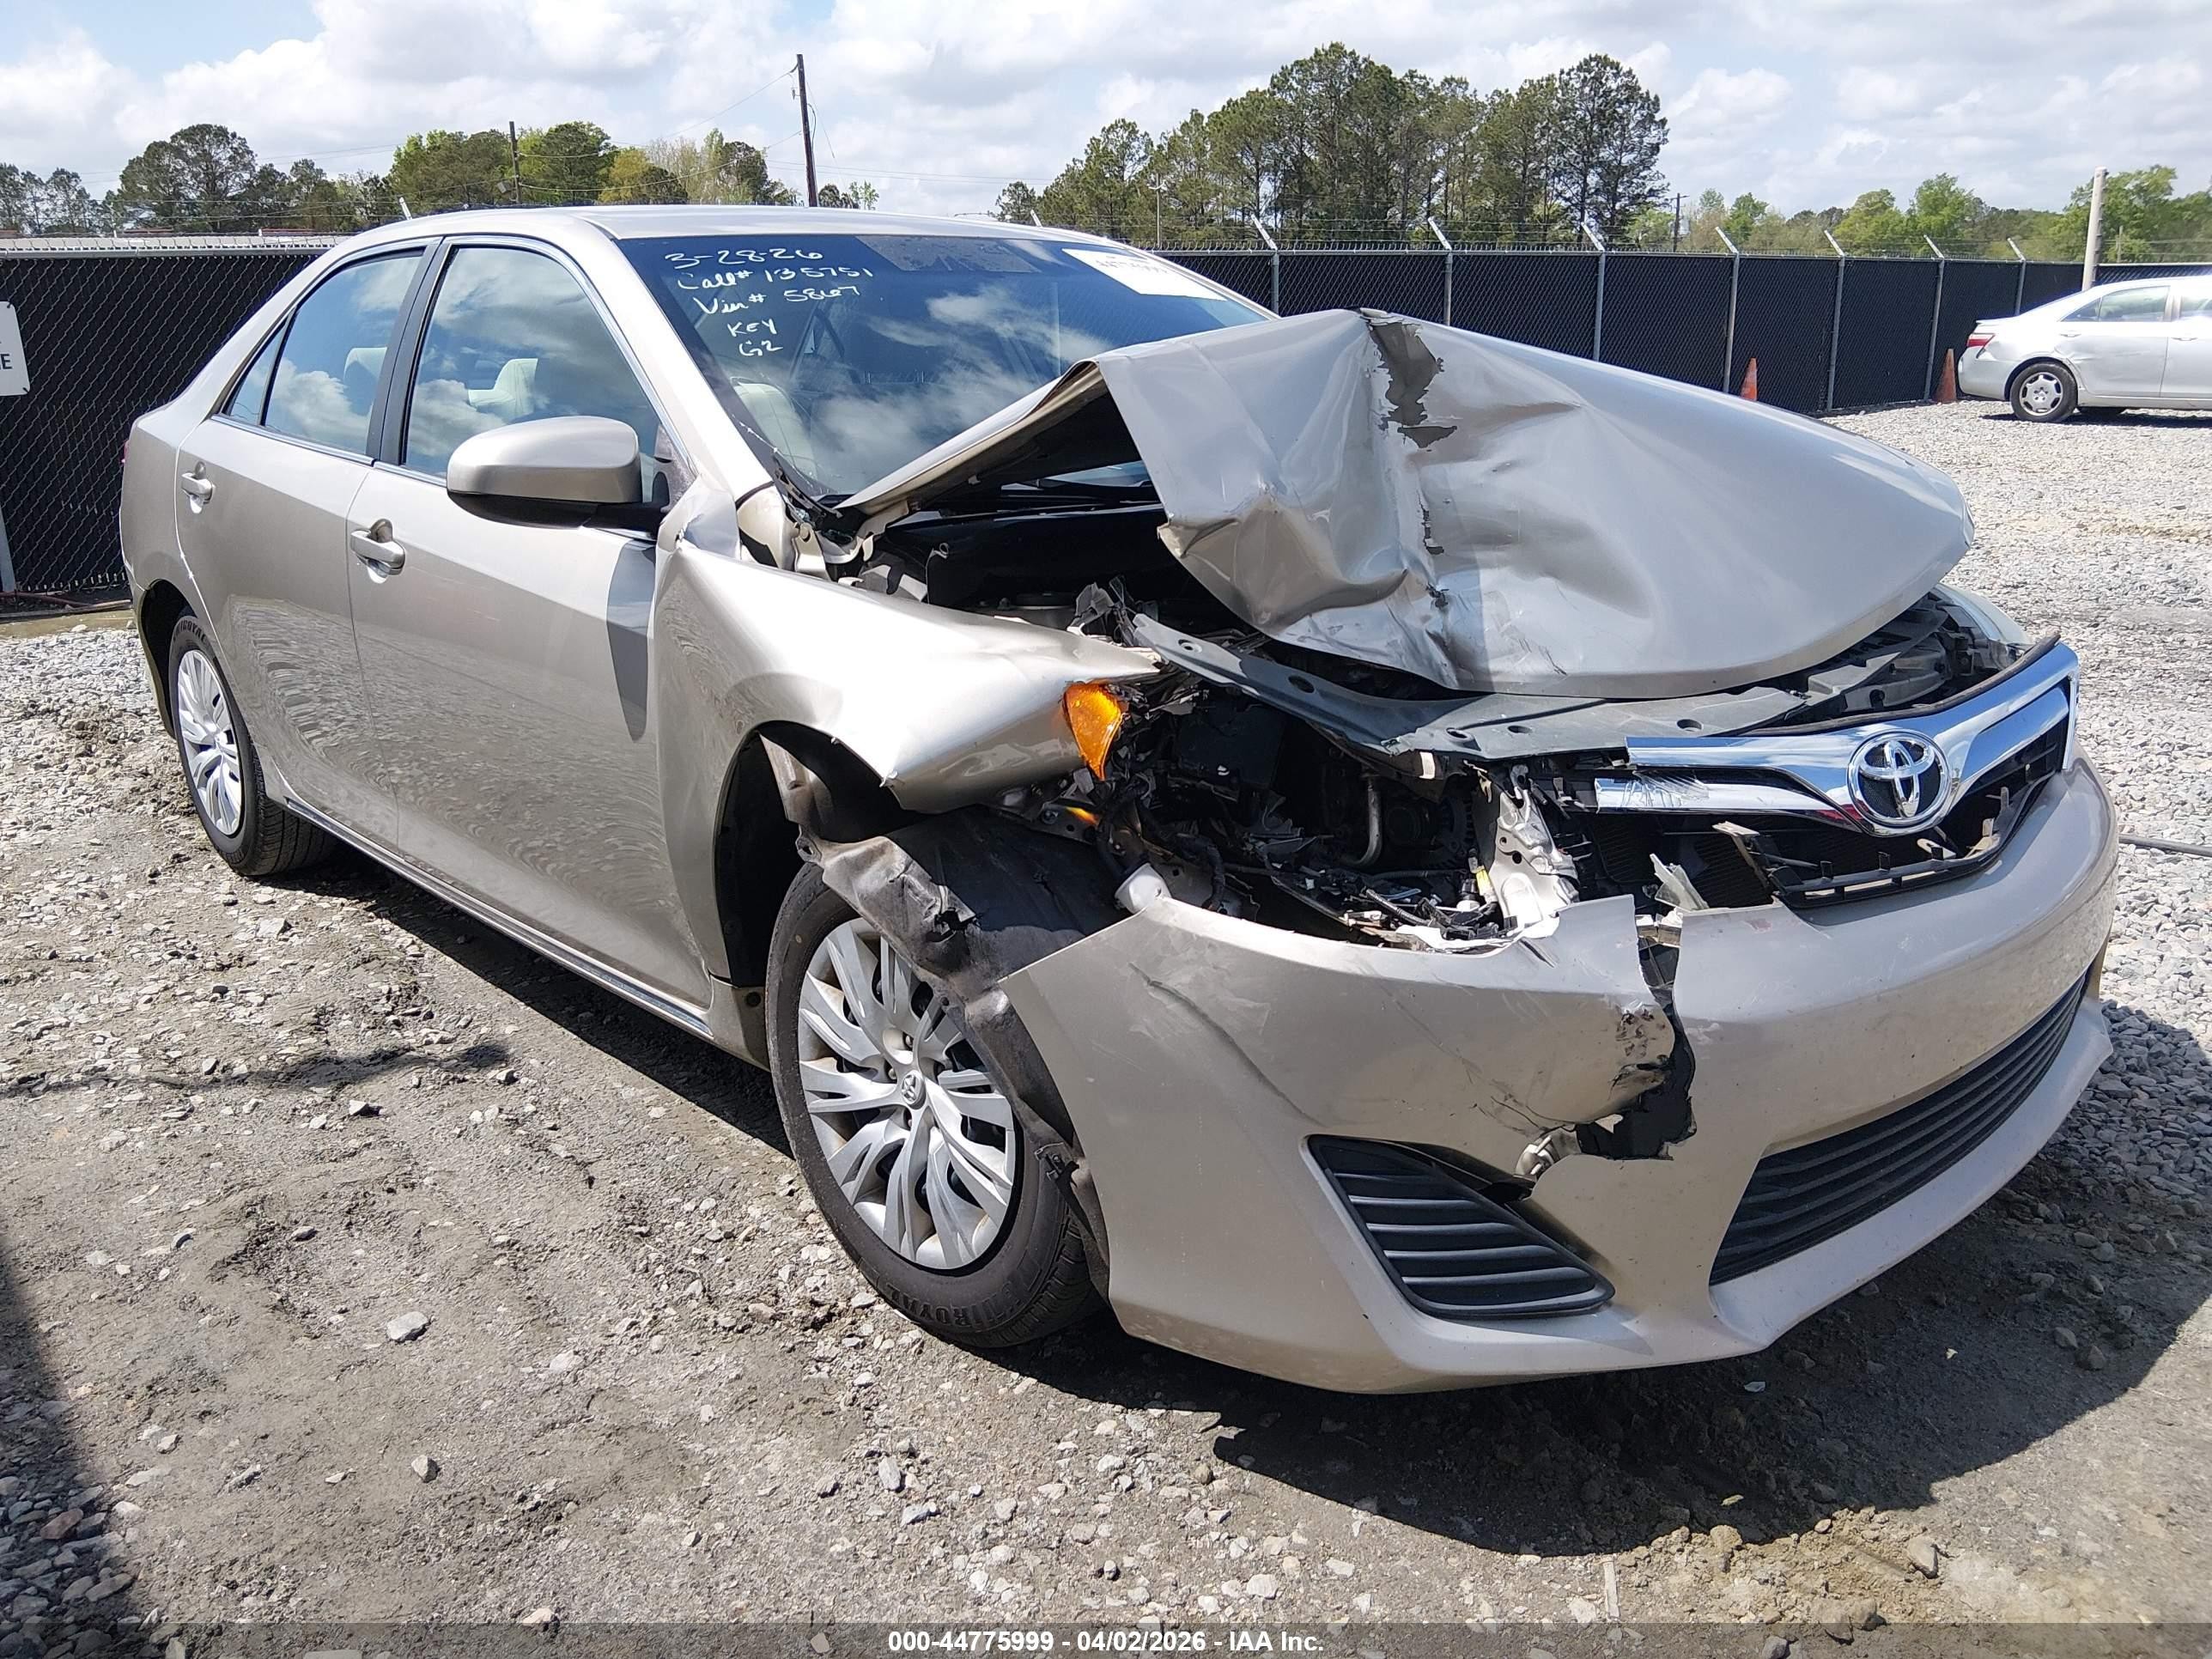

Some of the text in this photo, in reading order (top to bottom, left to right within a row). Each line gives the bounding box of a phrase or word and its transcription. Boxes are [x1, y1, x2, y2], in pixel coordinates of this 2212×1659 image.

[665, 248, 823, 270] 3-28-26
[764, 267, 873, 283] 135751
[727, 318, 777, 337] KEY
[0, 353, 13, 369] E
